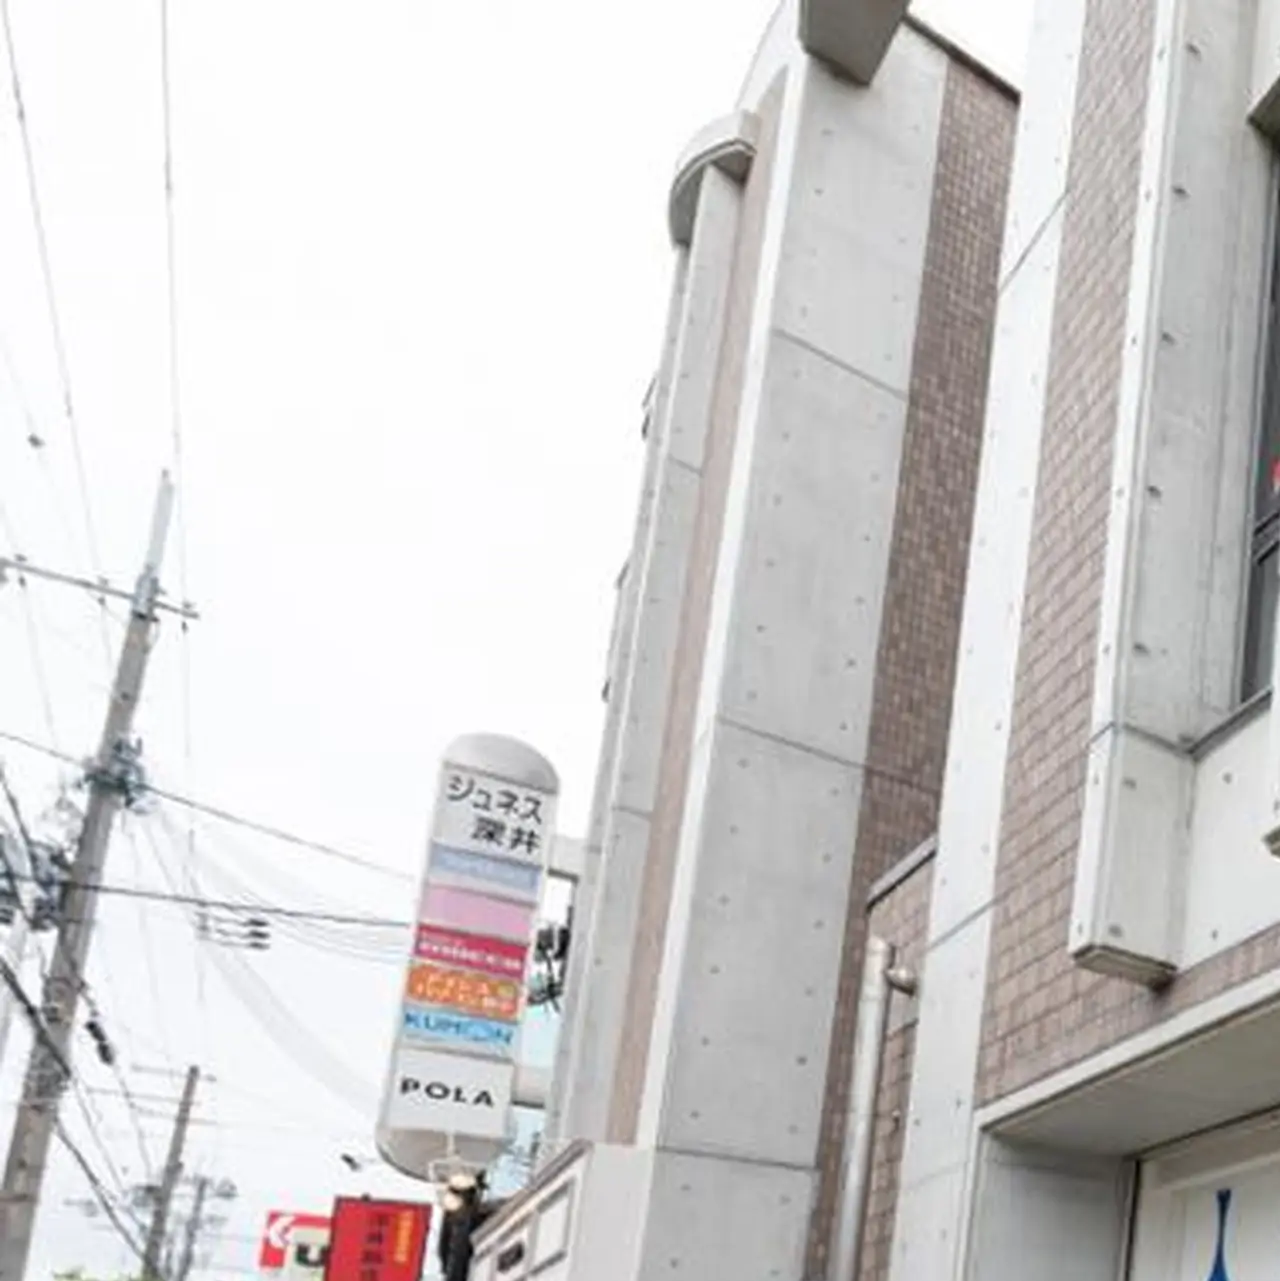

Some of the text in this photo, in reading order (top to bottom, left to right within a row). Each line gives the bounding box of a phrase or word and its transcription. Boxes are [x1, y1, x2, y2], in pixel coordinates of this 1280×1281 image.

[446, 774, 542, 826] ジュネス
[470, 815, 541, 855] 深井
[400, 1076, 497, 1109] POLA
